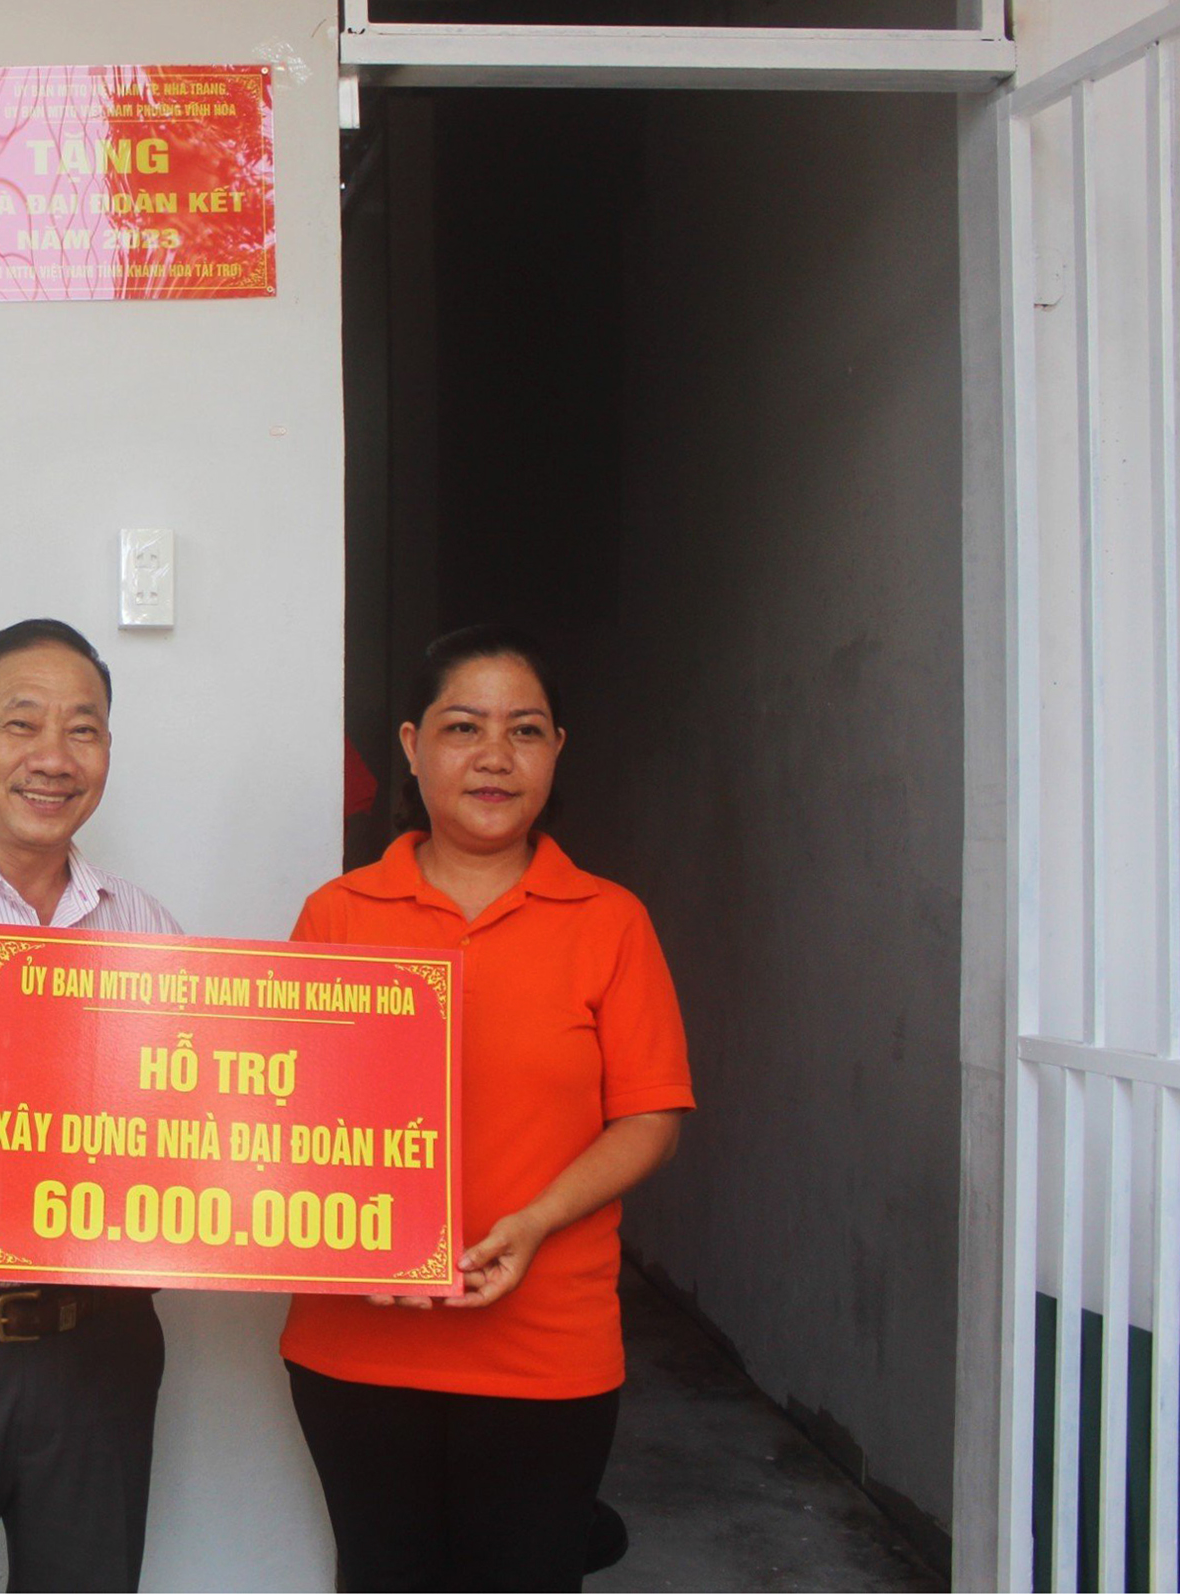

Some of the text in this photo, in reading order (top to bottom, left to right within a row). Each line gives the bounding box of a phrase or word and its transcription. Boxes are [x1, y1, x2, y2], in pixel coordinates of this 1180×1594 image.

[189, 83, 226, 95] TRANG
[26, 131, 169, 183] TẶNG
[26, 194, 78, 219] ĐẠI
[90, 189, 178, 214] ĐOÀN
[188, 185, 245, 213] KẾT
[17, 225, 181, 250] NĂM 2023
[21, 956, 415, 1016] ỦY BAN MTTQ VIỆT NAM TỈNH KHÁNH HÒA
[139, 1032, 298, 1106] HỖ TRỢ
[61, 1111, 147, 1163] DỰNG
[157, 1111, 223, 1161] NHÀ
[228, 1120, 281, 1172] ĐẠI
[290, 1118, 374, 1167] ĐOÀN
[384, 1117, 438, 1168] KẾT
[32, 1180, 394, 1251] 60.000.000đ
